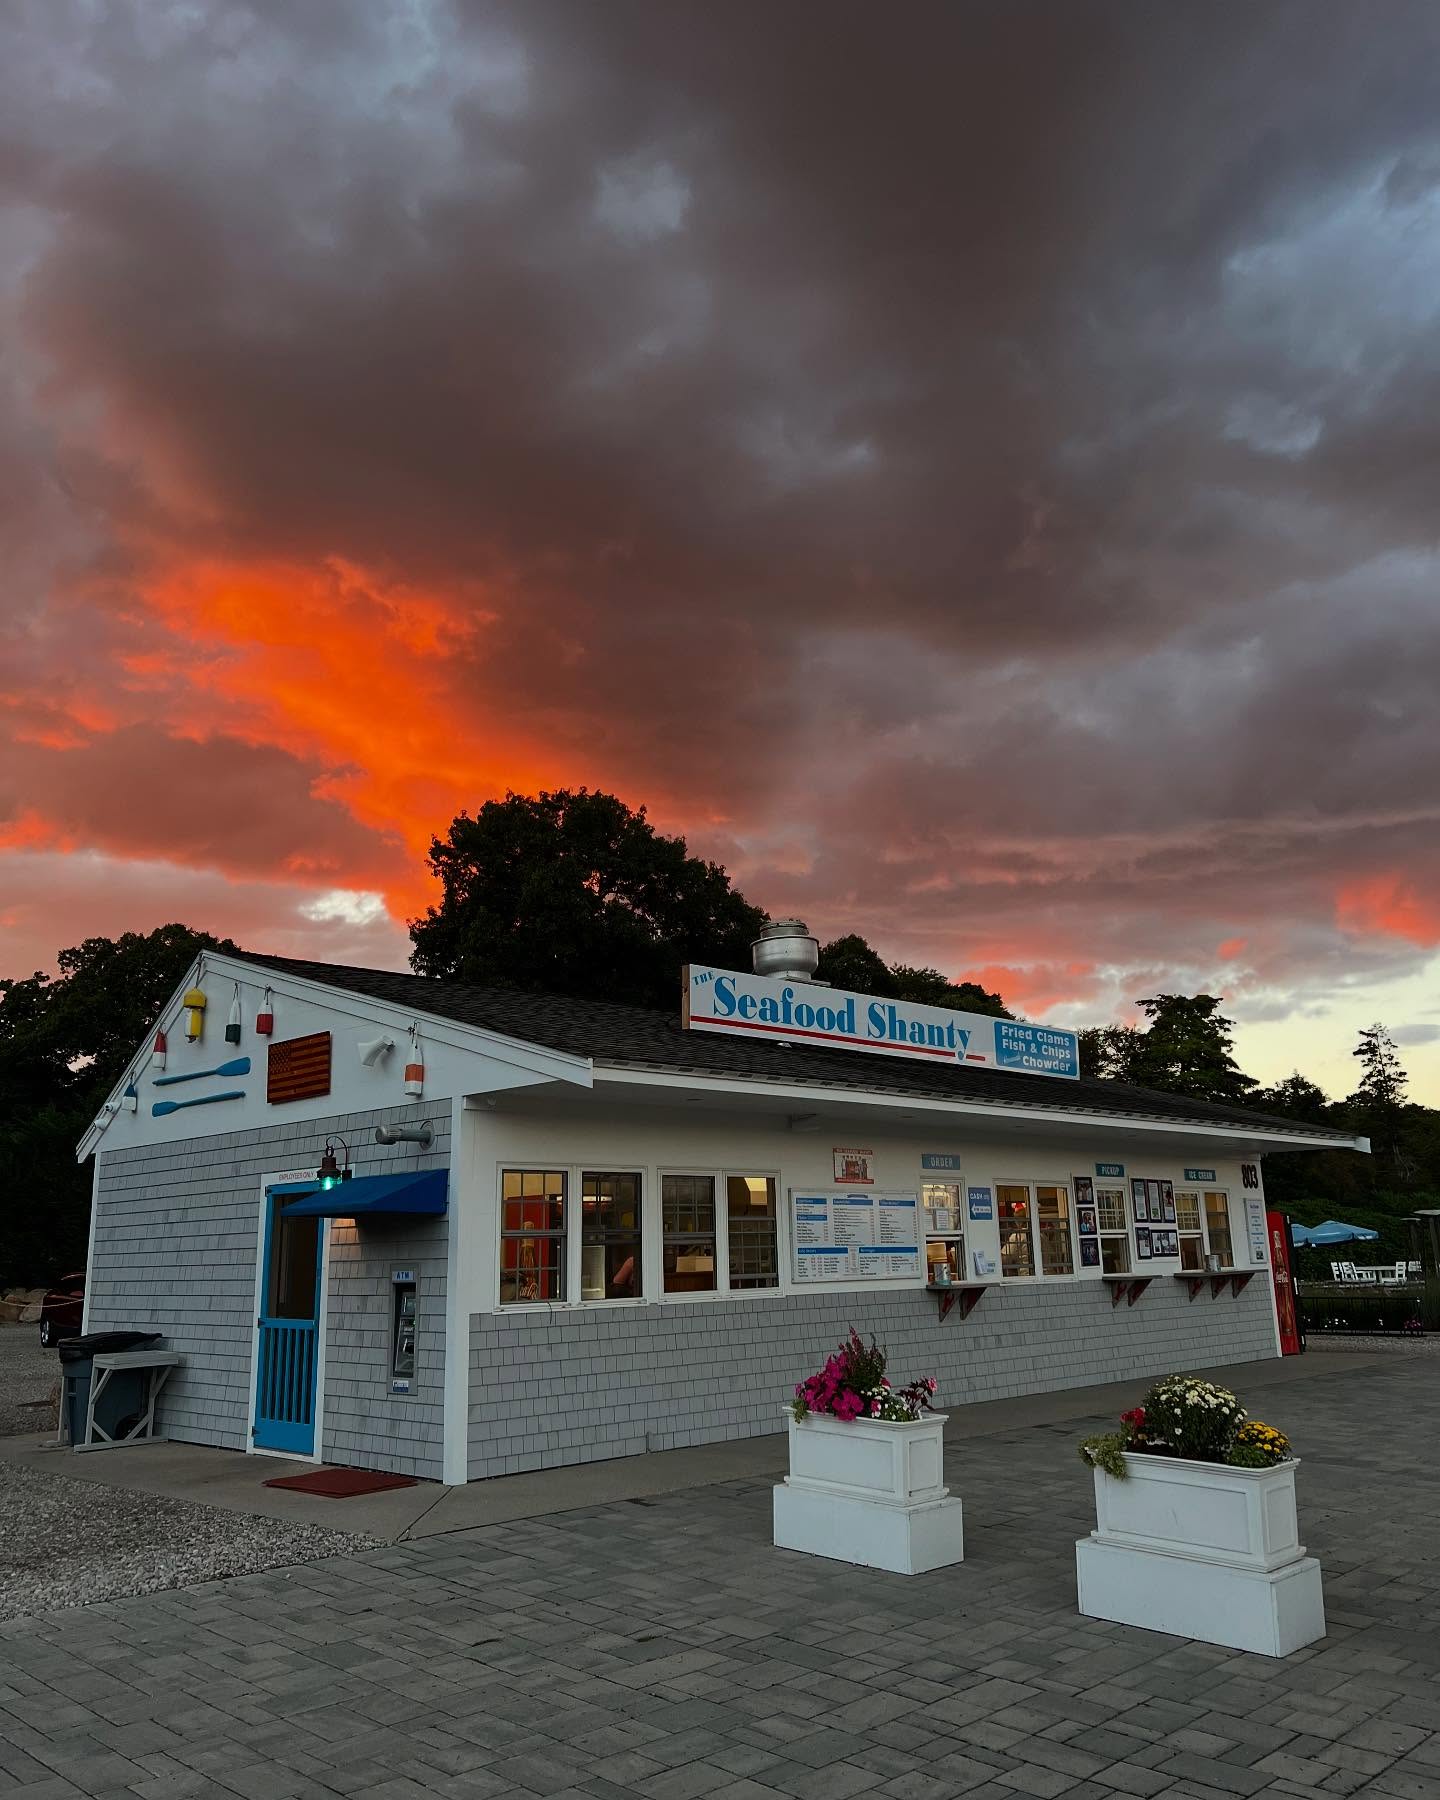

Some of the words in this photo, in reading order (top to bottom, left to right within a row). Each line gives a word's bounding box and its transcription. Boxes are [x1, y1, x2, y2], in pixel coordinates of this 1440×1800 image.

[692, 971, 714, 986] THE
[714, 976, 857, 1034] Seafood
[867, 1002, 972, 1061] Shanty
[1001, 1025, 1032, 1041] Fried
[1037, 1031, 1070, 1046] Clams
[1002, 1039, 1026, 1052] Fish
[1030, 1043, 1037, 1053] &
[1041, 1044, 1071, 1059] Chips
[1022, 1055, 1071, 1072] Chowder
[930, 1155, 953, 1168] ORDER
[279, 1172, 302, 1181] EMPLOYEES
[303, 1170, 314, 1179] ONLY
[1101, 1165, 1120, 1175] PICKUP
[1188, 1170, 1197, 1179] ICE
[1198, 1171, 1213, 1181] CREAM
[1241, 1164, 1259, 1189] 803
[396, 1272, 410, 1280] ATM
